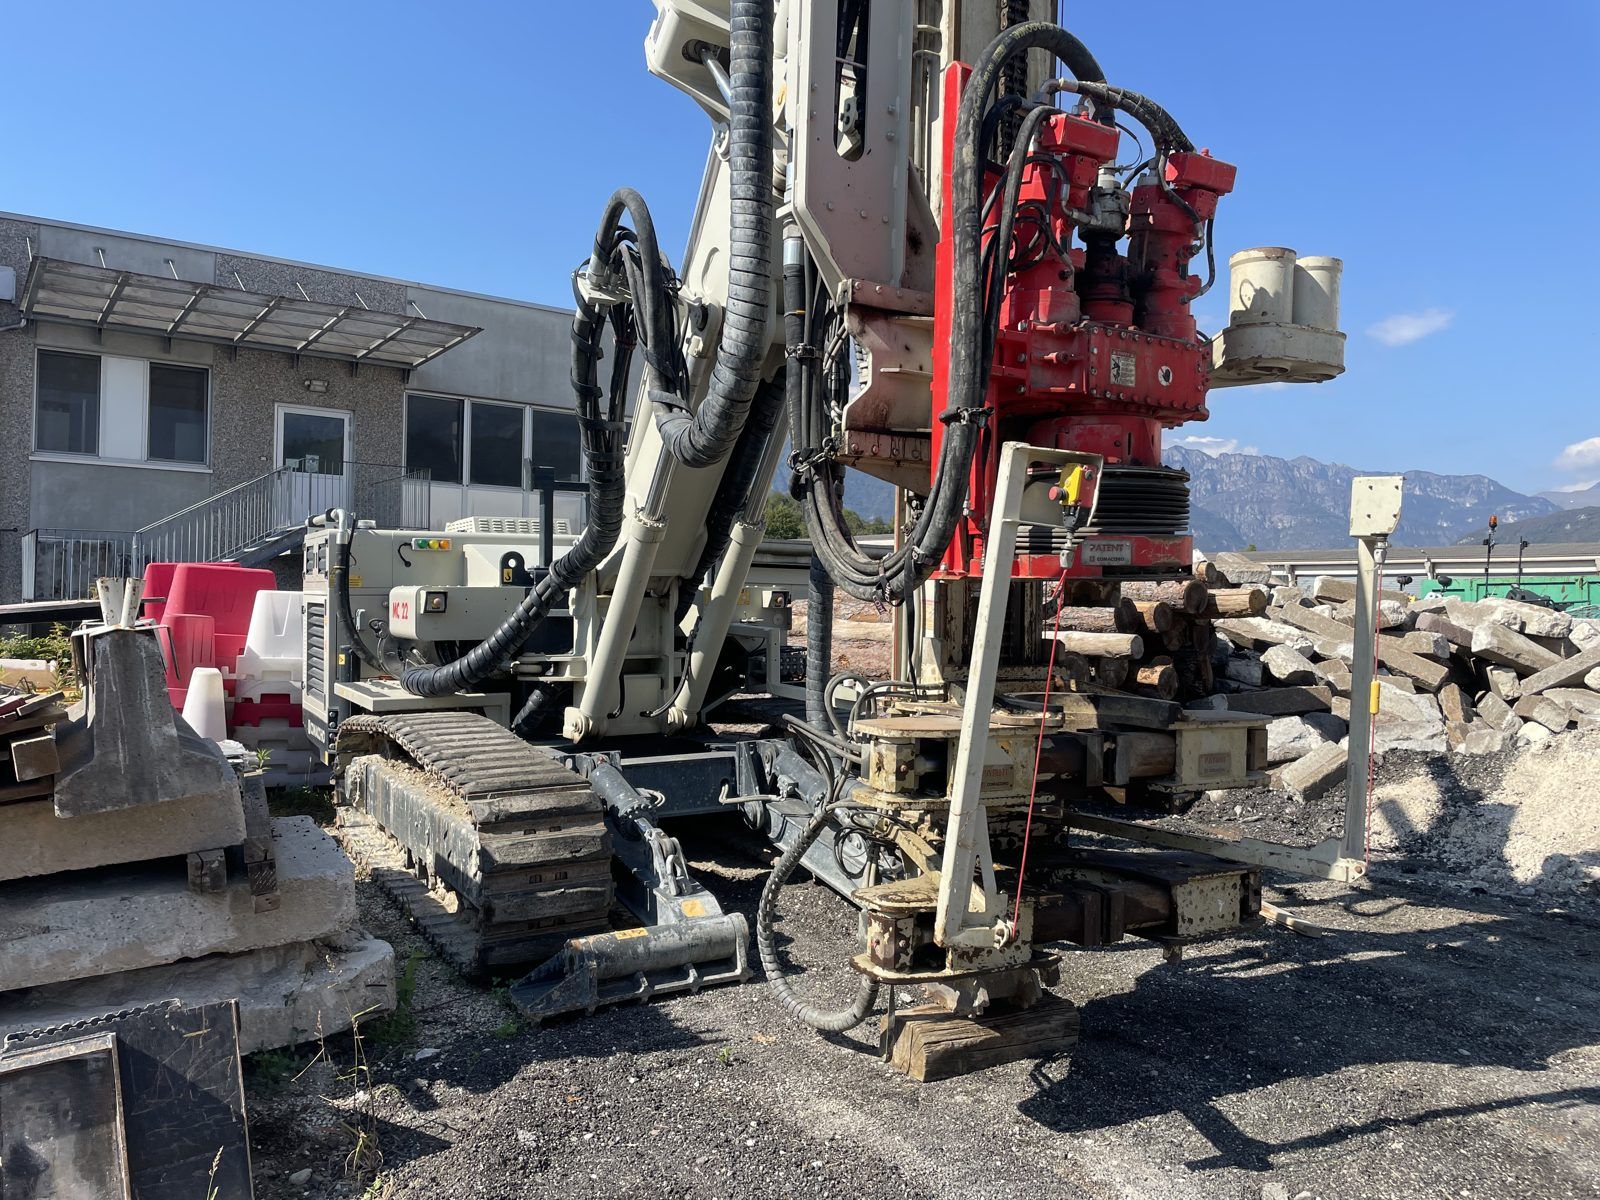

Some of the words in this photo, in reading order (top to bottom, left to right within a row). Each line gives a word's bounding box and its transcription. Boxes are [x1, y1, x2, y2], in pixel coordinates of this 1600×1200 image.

[1089, 543, 1124, 552] PATENT
[392, 601, 400, 619] MC
[401, 601, 409, 620] 22
